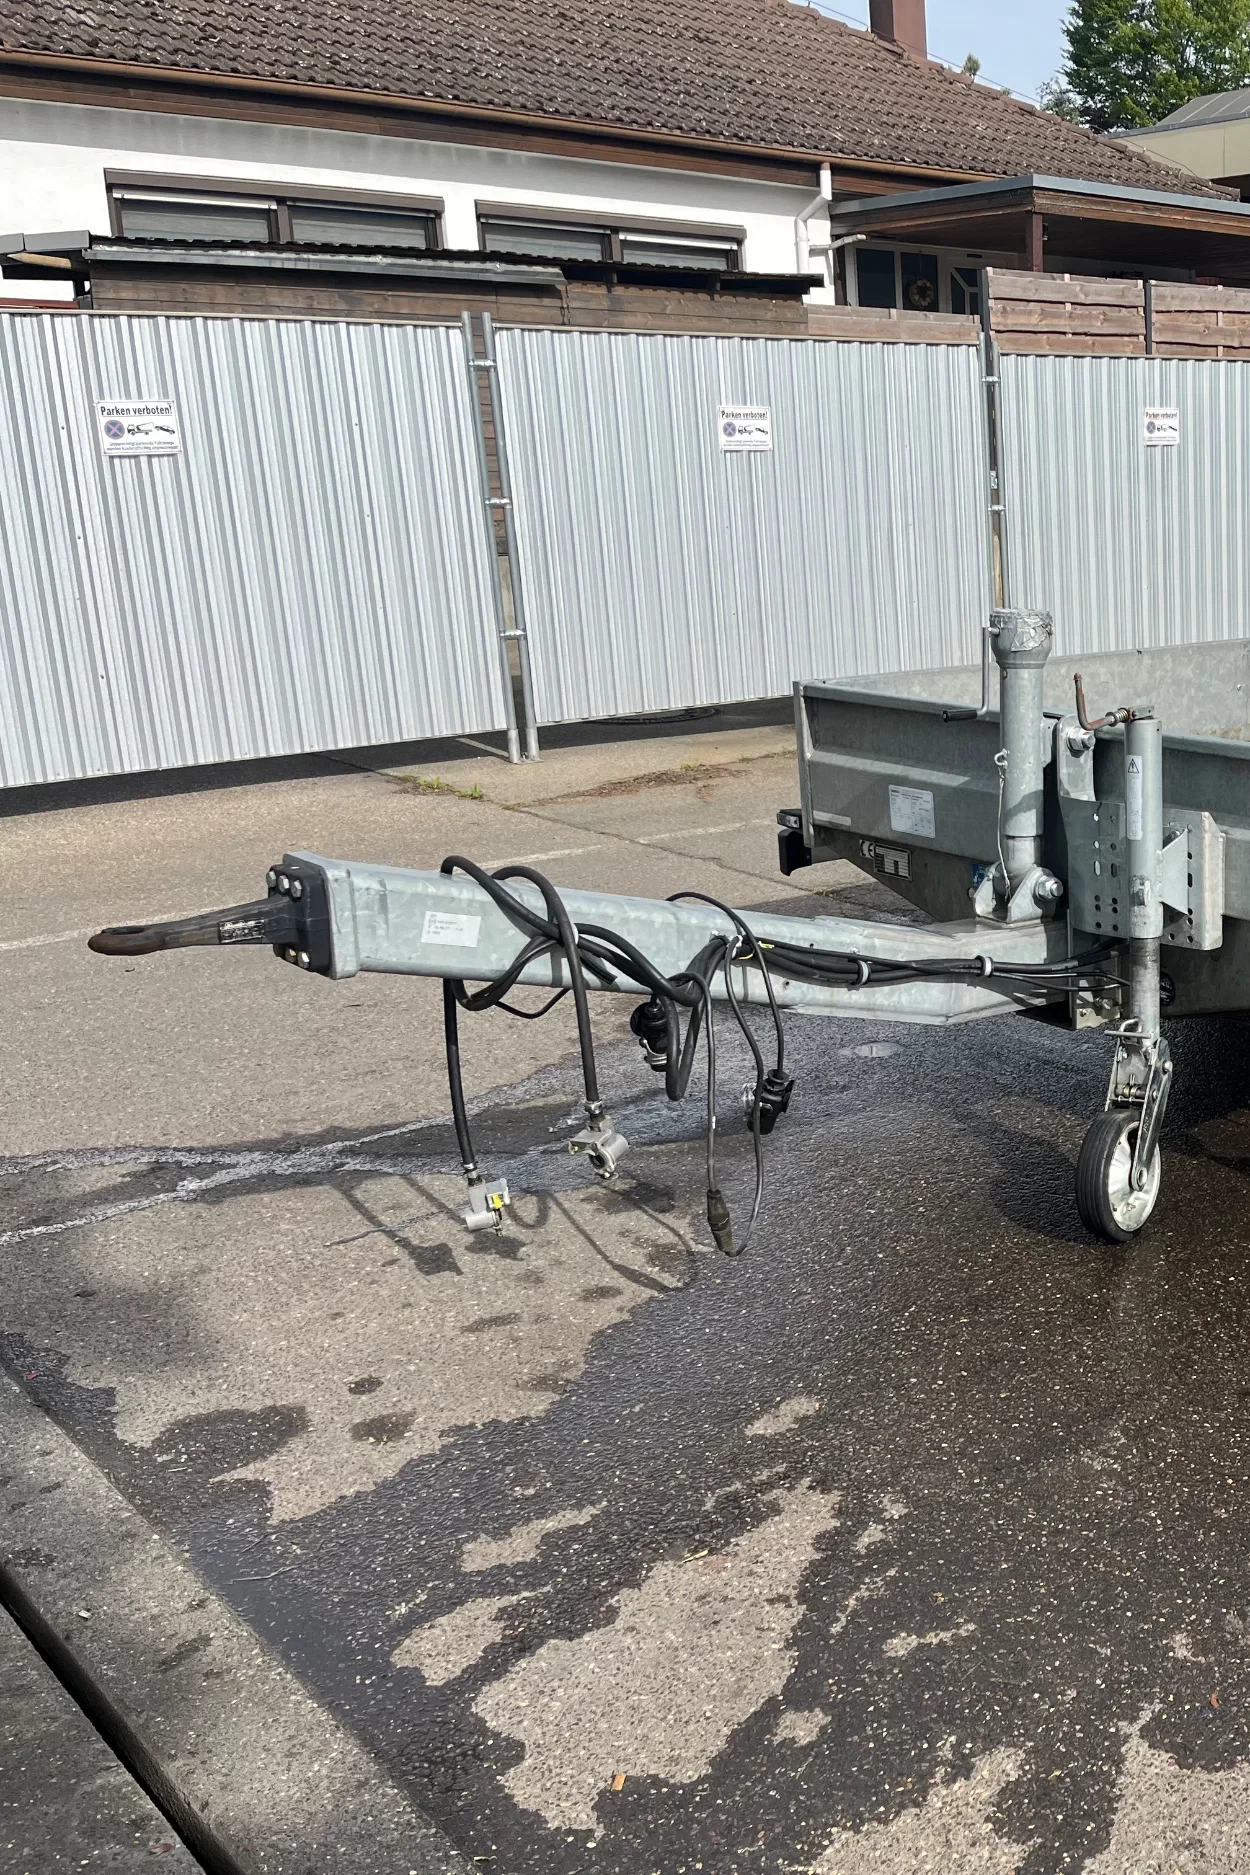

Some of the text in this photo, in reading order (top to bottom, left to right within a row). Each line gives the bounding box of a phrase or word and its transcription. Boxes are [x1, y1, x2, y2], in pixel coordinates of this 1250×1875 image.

[100, 404, 173, 416] Parken verboten!
[721, 410, 742, 419] Parken
